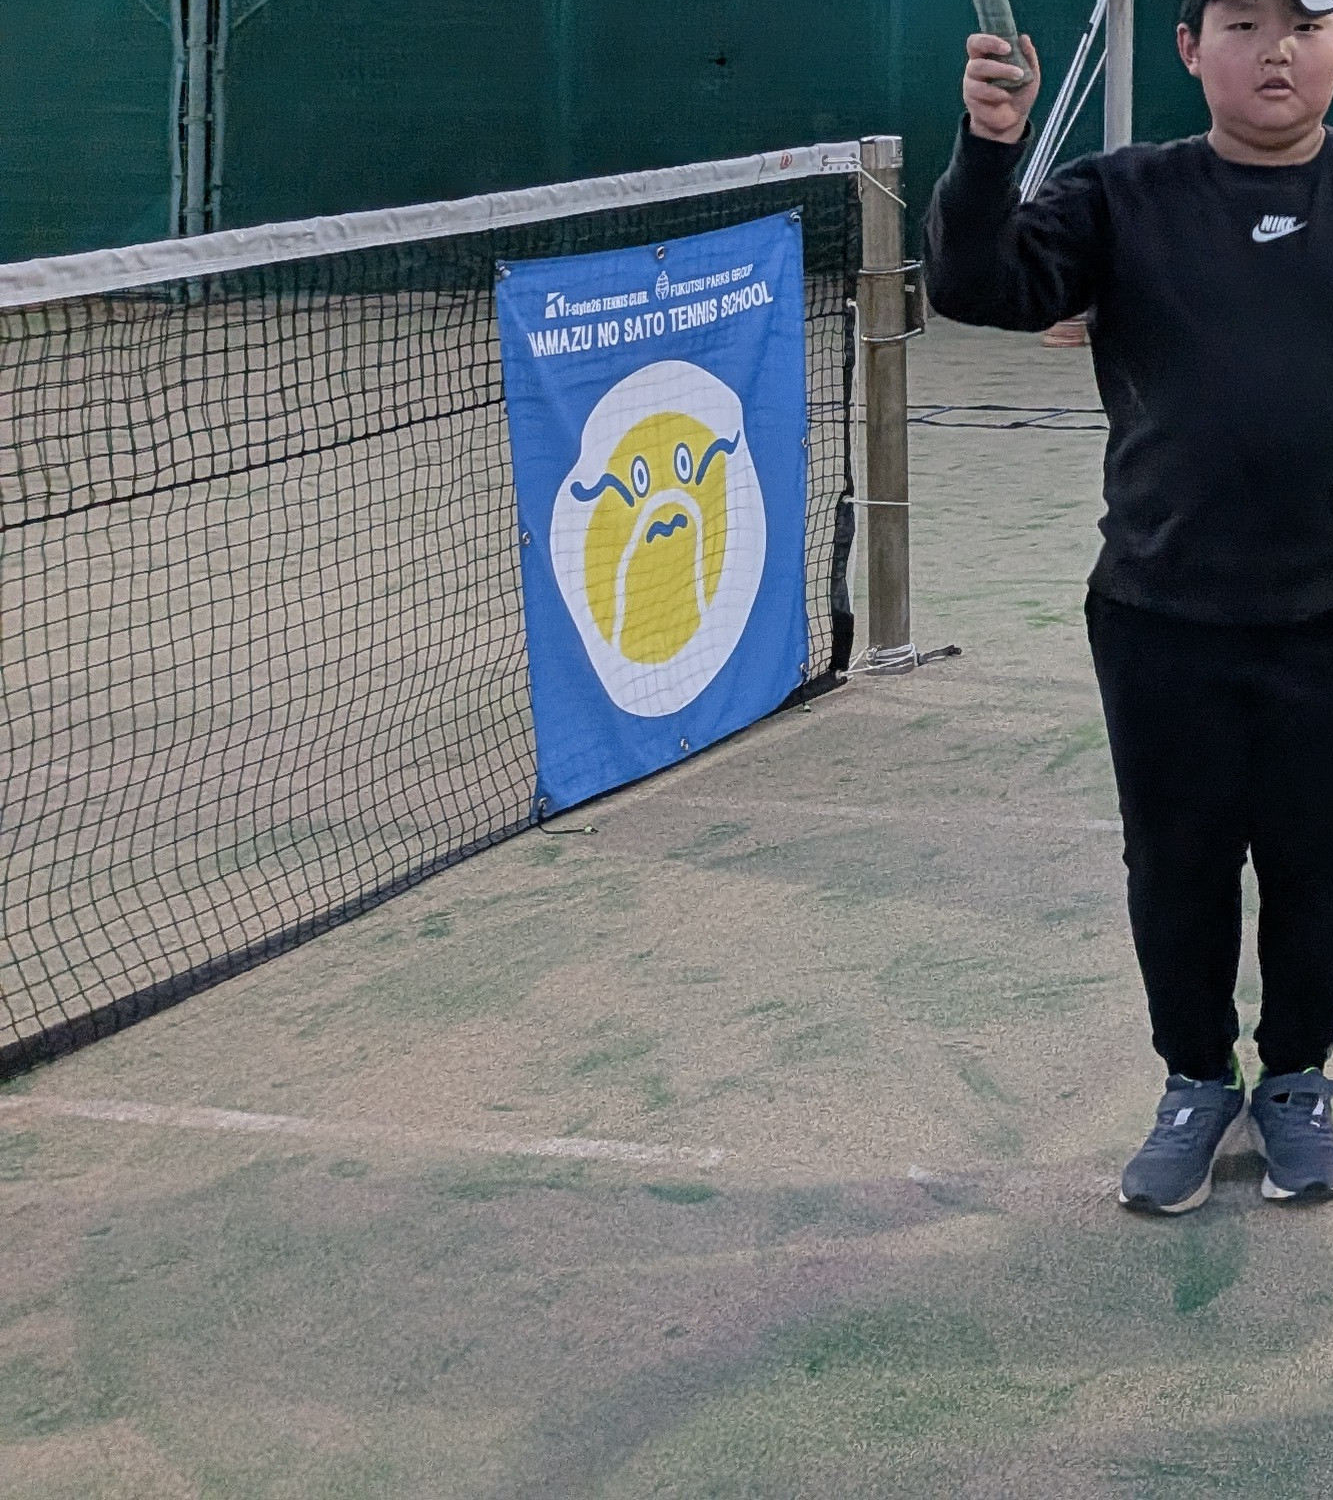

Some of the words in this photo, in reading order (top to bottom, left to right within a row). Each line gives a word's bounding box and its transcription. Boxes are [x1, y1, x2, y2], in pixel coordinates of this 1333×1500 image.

[1260, 214, 1297, 232] NIKE
[670, 278, 705, 298] FUKUTSU
[706, 271, 730, 289] PARKS
[731, 263, 754, 283] GROUP
[597, 320, 620, 348] NO
[624, 311, 665, 343] SATO
[668, 298, 718, 332] TENNIS
[721, 280, 774, 318] SCHOOL
[602, 294, 629, 311] TENNIS
